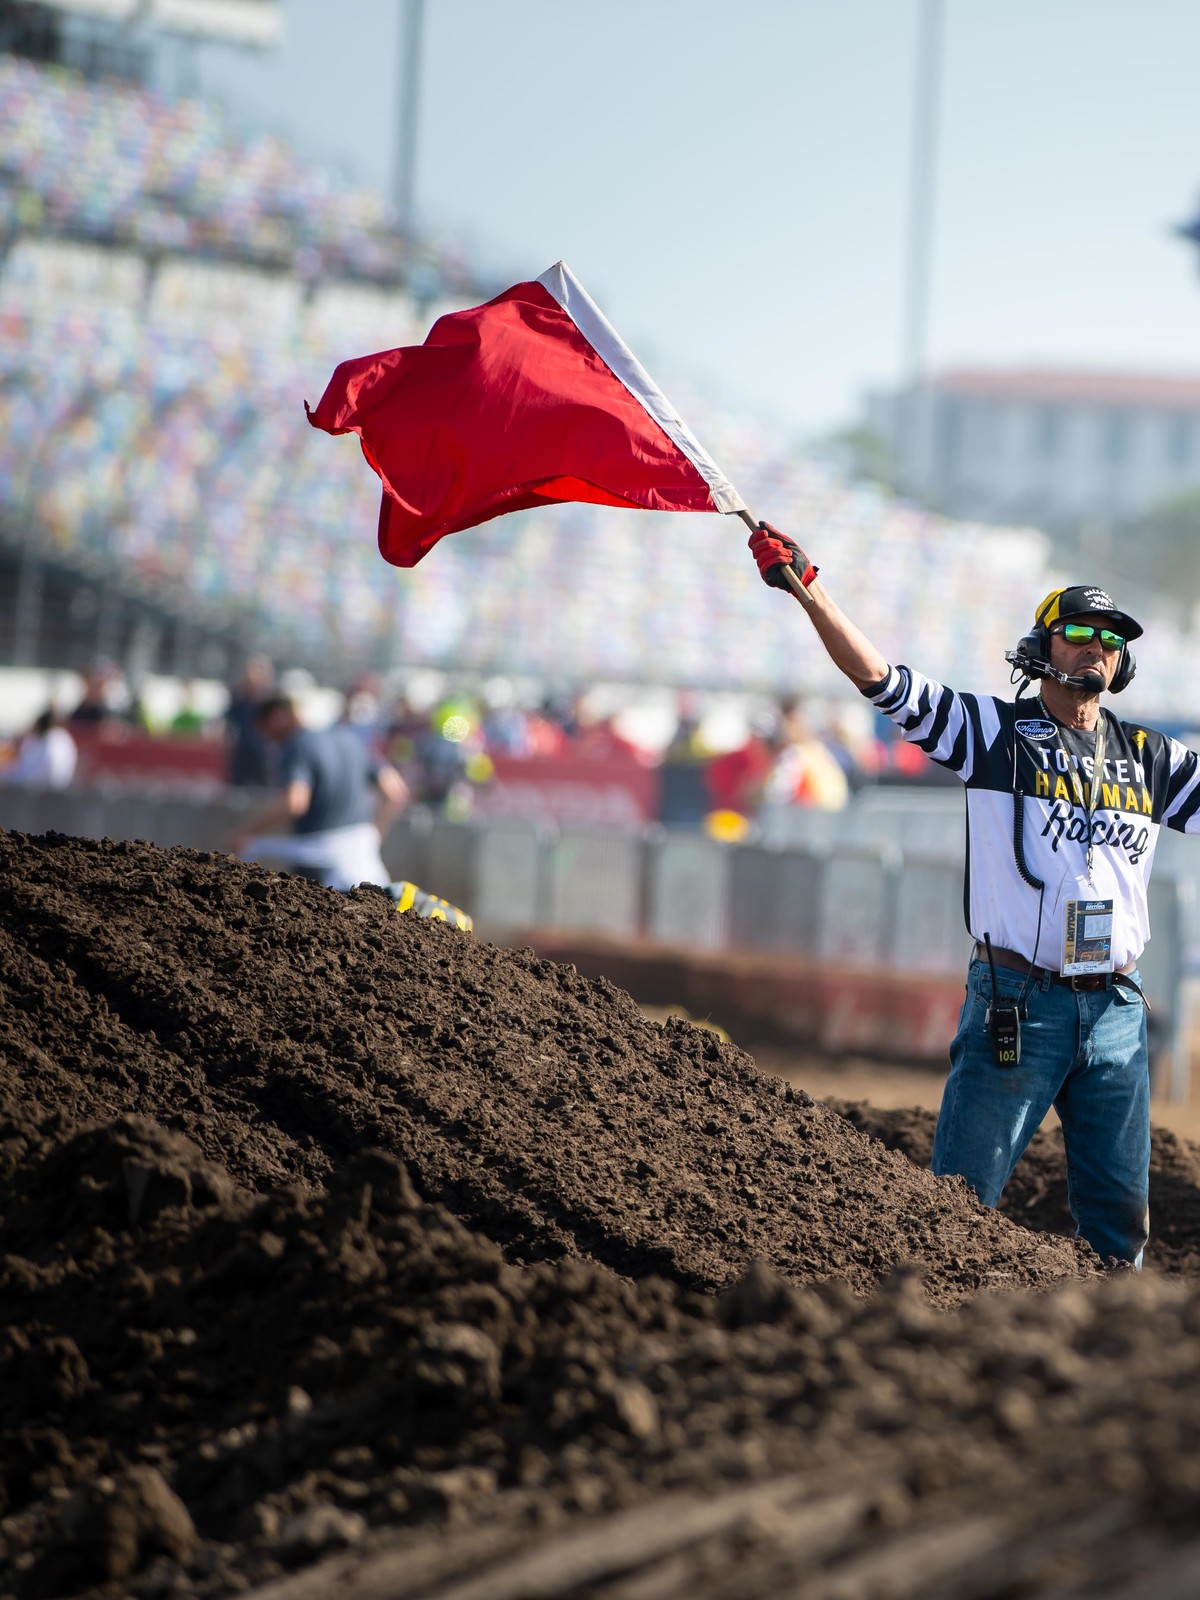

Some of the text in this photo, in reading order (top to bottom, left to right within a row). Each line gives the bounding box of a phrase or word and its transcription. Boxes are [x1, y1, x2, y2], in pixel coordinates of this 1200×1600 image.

[1040, 799, 1149, 866] Racing
[1067, 903, 1076, 942] DAYTONA
[999, 1050, 1016, 1062] 102
